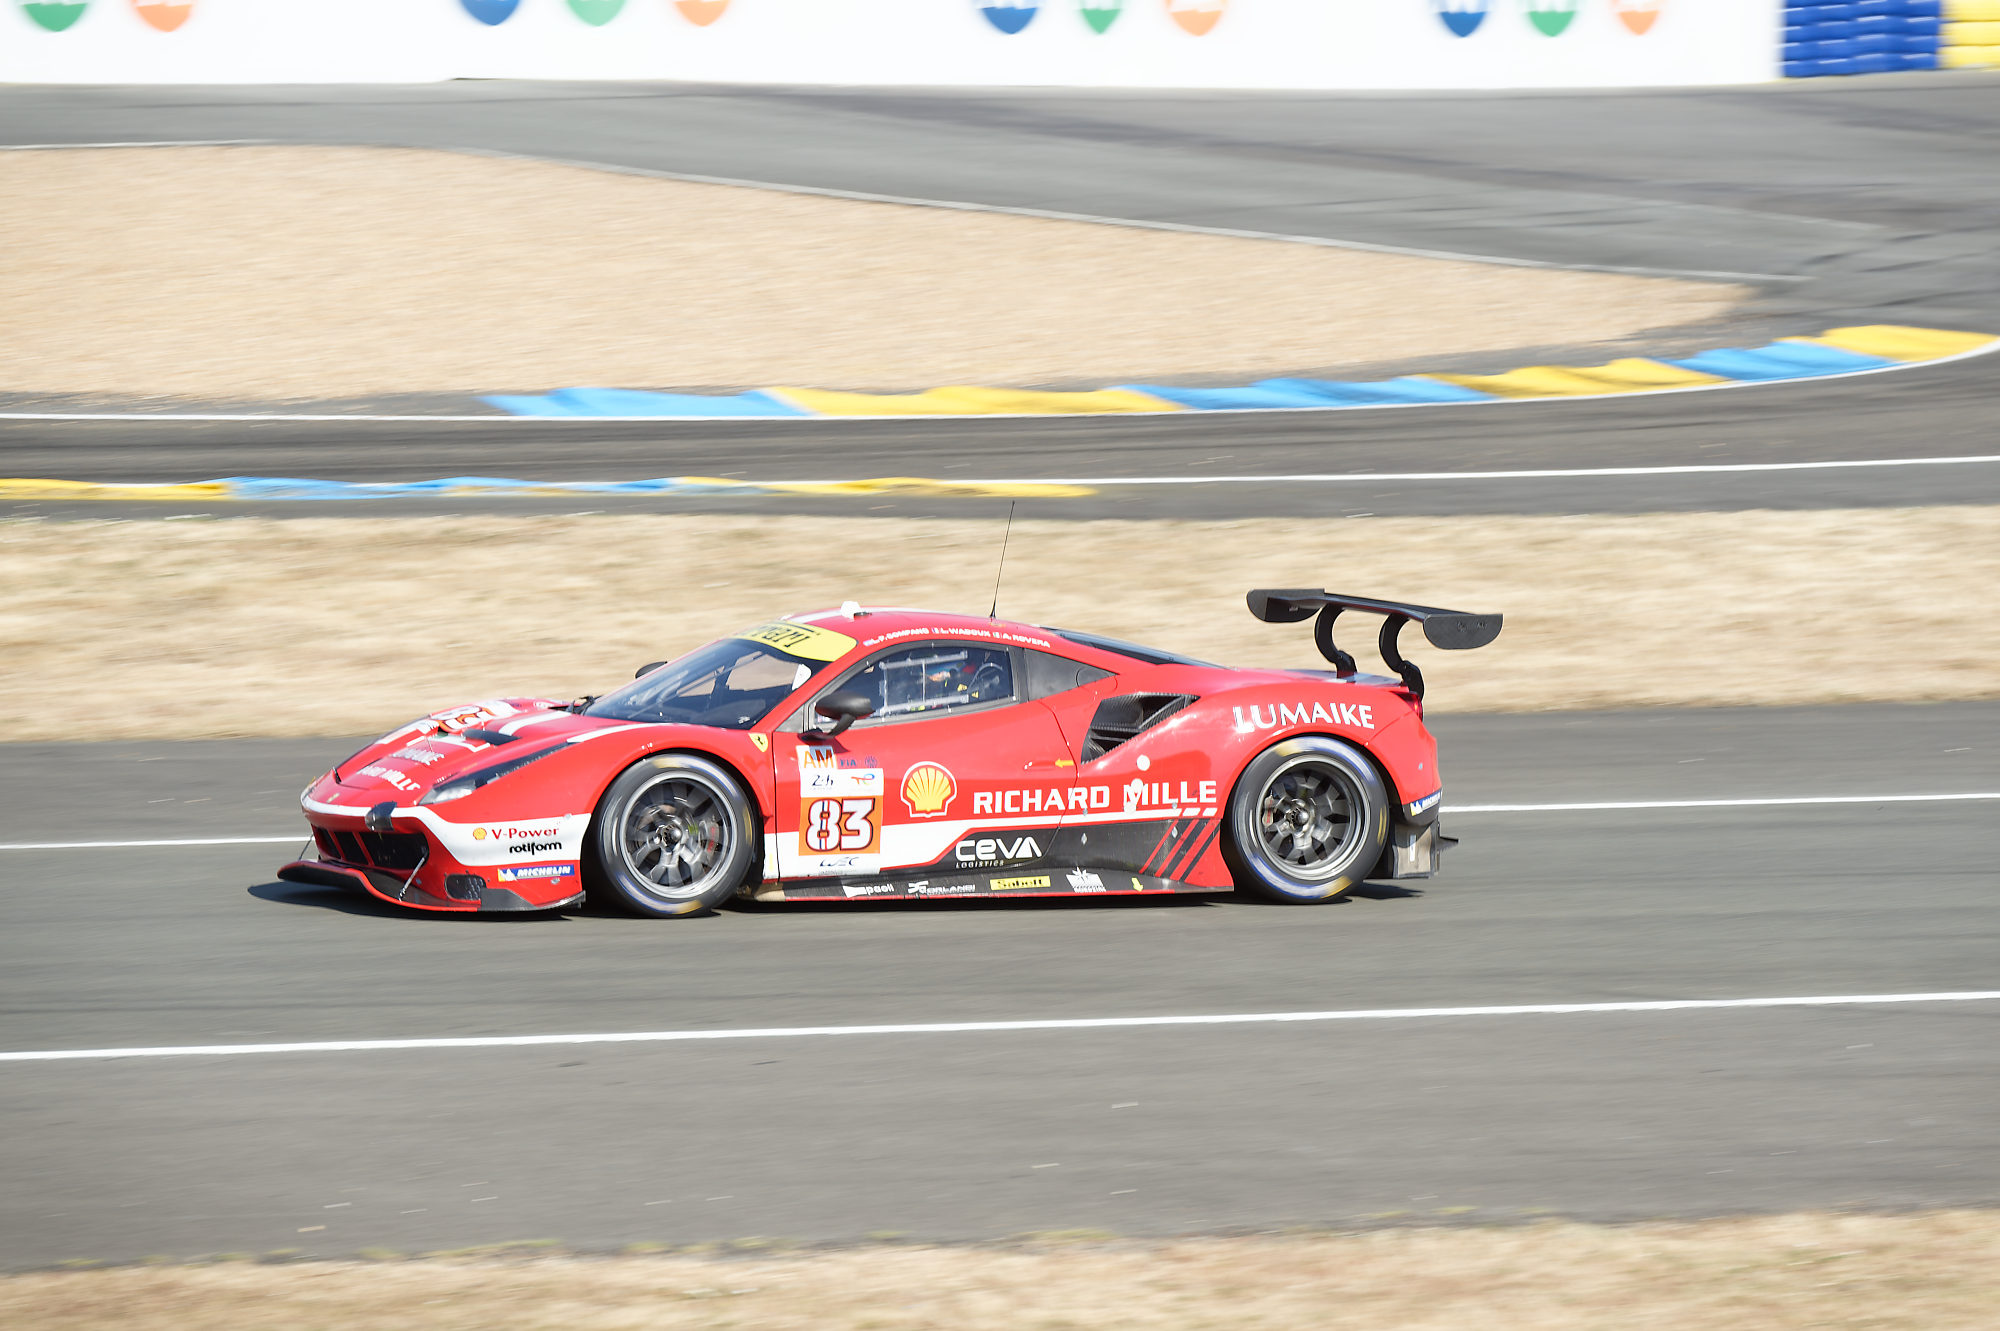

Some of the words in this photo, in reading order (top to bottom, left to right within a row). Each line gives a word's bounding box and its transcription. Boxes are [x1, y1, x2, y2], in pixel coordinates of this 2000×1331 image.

[1233, 702, 1375, 733] LUMAIKE
[803, 749, 834, 768] AM
[973, 785, 1110, 814] RICHARD
[1123, 780, 1217, 806] MILLE
[806, 798, 875, 851] 83
[491, 828, 559, 839] V-Power
[509, 842, 562, 855] rotiform
[516, 865, 571, 877] MICHELIN
[955, 860, 1004, 869] LOGISTICS
